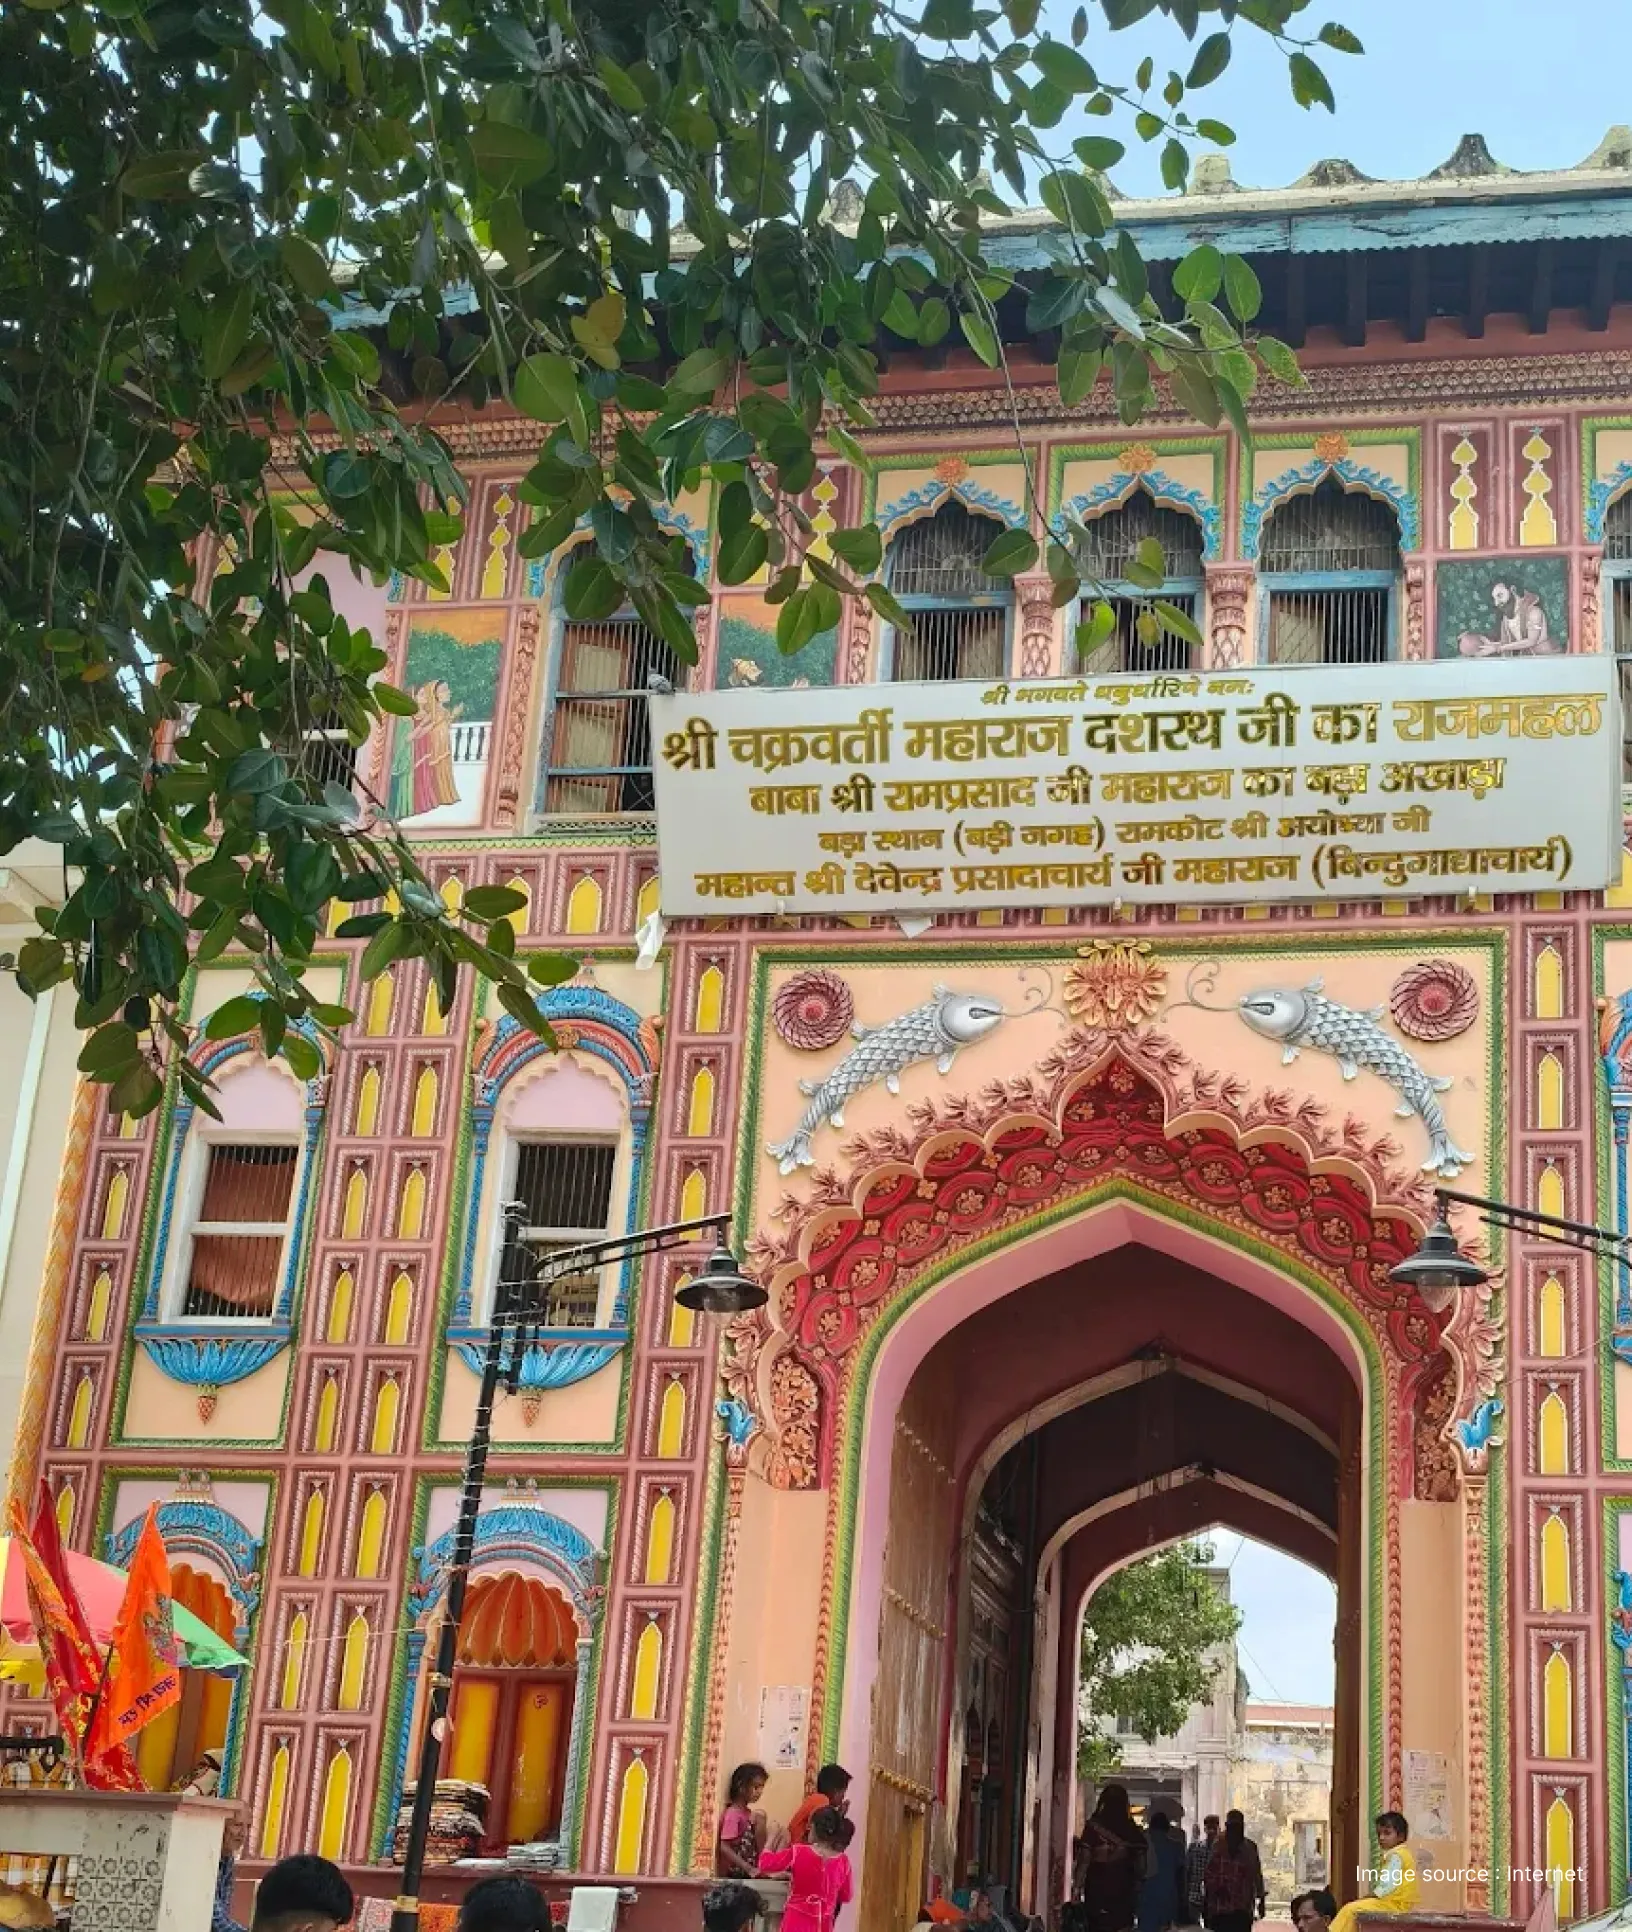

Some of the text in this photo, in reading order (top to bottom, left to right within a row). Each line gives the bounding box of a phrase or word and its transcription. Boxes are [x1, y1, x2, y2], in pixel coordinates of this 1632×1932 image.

[980, 684, 1010, 706] श्री
[661, 692, 1607, 773] श्री चक्रवर्ती महाराज दशरथ जी का राजमहल
[749, 758, 1507, 816] बाबा श्री रामप्रसाद जी महाराज का बड़ा अखाड़ा
[818, 831, 866, 858] बड़ा
[873, 829, 944, 852] स्थान
[954, 820, 1014, 856] (बड़ी
[1115, 812, 1226, 844] रामकोट
[1230, 811, 1270, 840] श्री
[1393, 805, 1432, 834] जी
[695, 870, 796, 898] महान्त
[803, 863, 845, 895] श्री
[853, 862, 944, 895] देवेन्द्र
[951, 853, 1113, 893] प्रसादाचार्य
[1121, 854, 1166, 885] जी
[1173, 855, 1300, 883] महाराज
